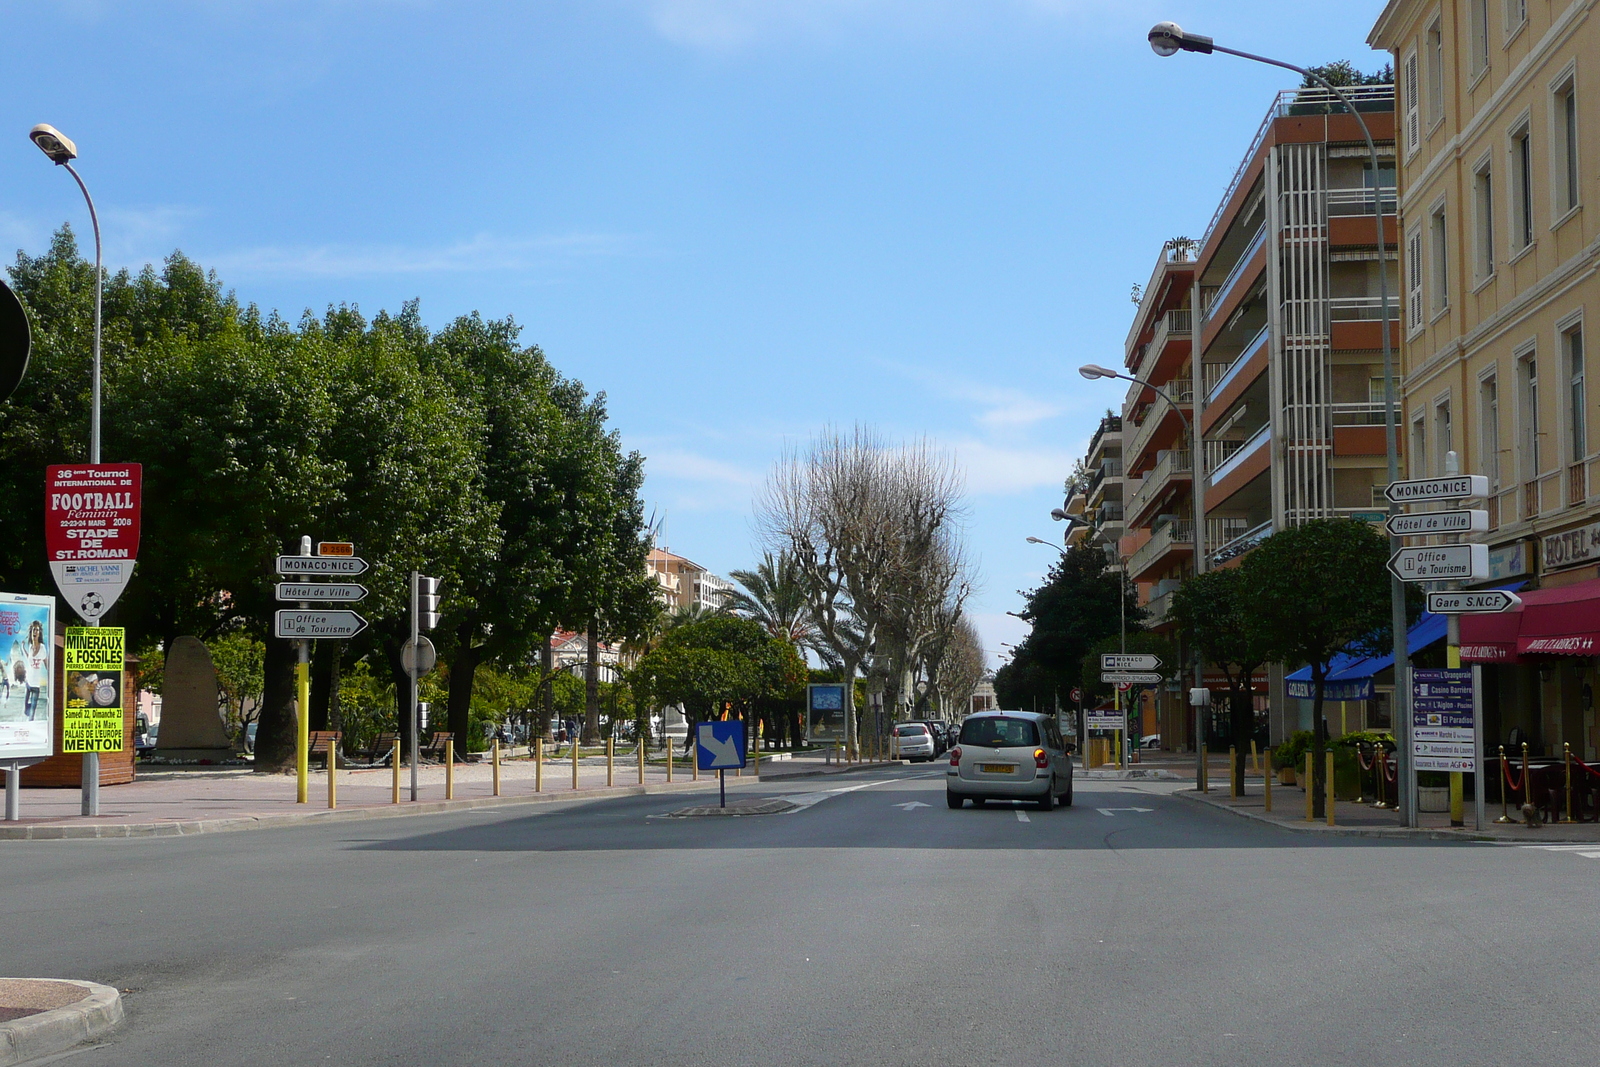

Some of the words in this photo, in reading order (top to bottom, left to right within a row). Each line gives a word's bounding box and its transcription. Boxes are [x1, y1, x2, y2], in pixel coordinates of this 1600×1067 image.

[58, 470, 72, 478] 36
[87, 469, 129, 478] Tournoi
[52, 492, 134, 510] FOOTBALL
[67, 509, 118, 518] Féminin
[1397, 518, 1422, 530] Hôtel
[1427, 518, 1438, 528] de
[1443, 516, 1466, 527] Ville
[66, 529, 118, 539] STADE
[81, 539, 102, 548] DE
[1545, 528, 1589, 565] HOTEL
[1418, 552, 1446, 562] Office
[1418, 565, 1426, 575] de
[1430, 564, 1466, 574] Tourisme
[285, 588, 310, 596] Hôtel
[314, 588, 324, 596] de
[329, 588, 350, 596] Ville
[1436, 598, 1459, 608] Gare
[296, 615, 326, 623] Office
[311, 624, 351, 633] Tourisme
[67, 636, 122, 649] MINERAUX
[67, 651, 73, 663] &
[76, 650, 122, 663] FOSSILES
[1288, 682, 1309, 697] GOLDEN
[66, 709, 82, 718] Samedi
[93, 709, 115, 718] Dimanche
[116, 709, 122, 718] 23
[71, 721, 76, 729] et
[78, 720, 93, 729] Lundi
[95, 720, 101, 729] 24
[103, 720, 116, 729] Mars
[65, 730, 84, 738] PALAIS
[86, 730, 93, 738] DE
[95, 730, 122, 738] L'EUROPE
[65, 739, 121, 750] MENTON
